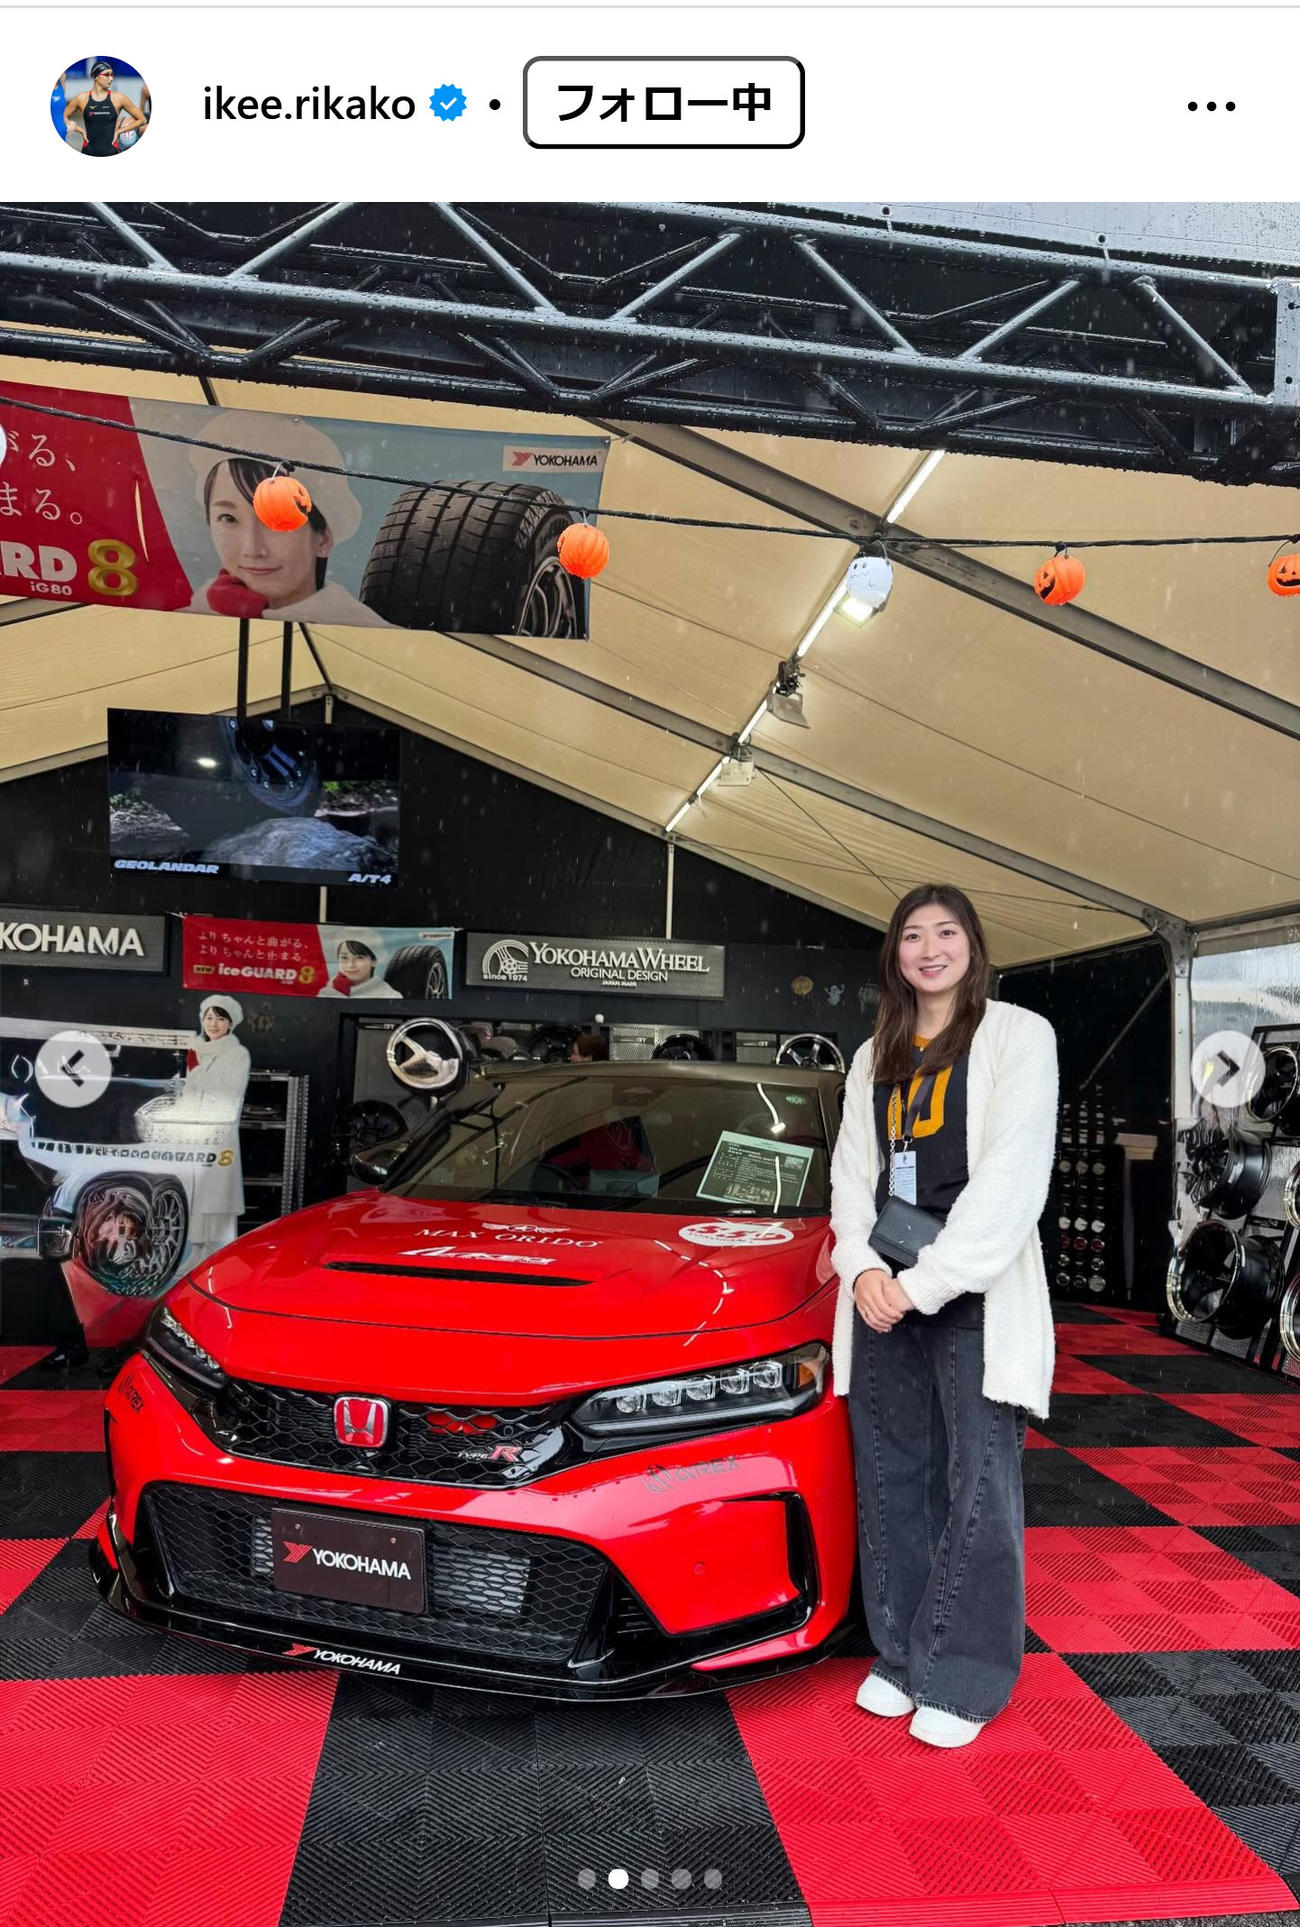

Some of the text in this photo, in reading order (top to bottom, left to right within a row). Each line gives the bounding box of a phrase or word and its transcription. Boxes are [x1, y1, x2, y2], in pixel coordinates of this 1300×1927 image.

[533, 453, 598, 467] YOKOHAMA
[0, 538, 138, 597] RD 8
[30, 581, 73, 596] iG80
[113, 858, 220, 875] GEOLANDAR
[347, 873, 392, 885] A/T4
[0, 921, 145, 957] KOHAMA
[528, 941, 710, 973] YOKOHAMA WHEEL
[218, 962, 298, 981] iceGUARD
[298, 965, 316, 985] 8
[508, 973, 528, 982] 1974
[570, 967, 668, 982] ORIGINAL DESIGN
[413, 1227, 599, 1248] MAX ORIDO
[491, 1445, 522, 1462] R
[312, 1548, 412, 1581] YOKOHAMA
[312, 1649, 401, 1675] YOKOHAMA
